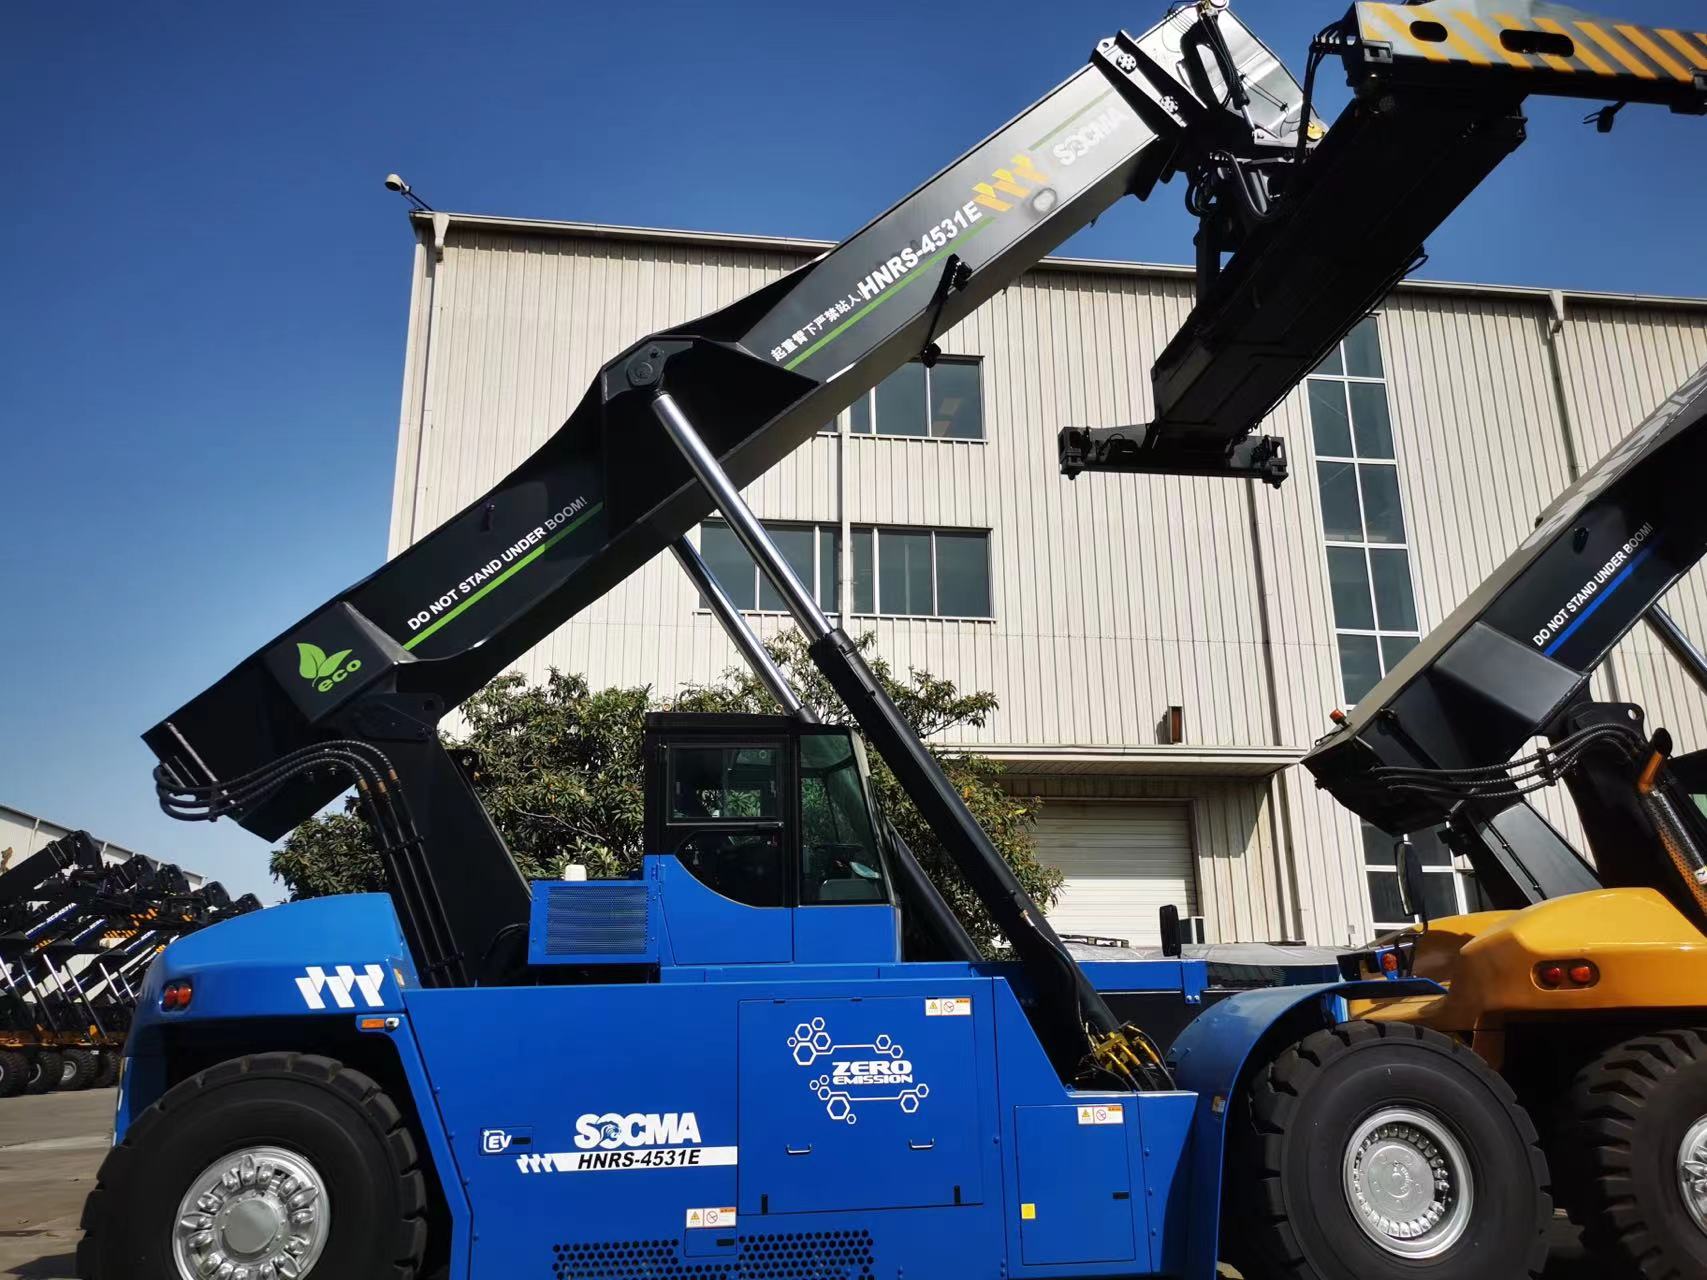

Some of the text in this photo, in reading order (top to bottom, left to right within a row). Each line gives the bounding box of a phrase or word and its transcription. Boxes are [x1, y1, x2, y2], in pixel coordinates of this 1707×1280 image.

[857, 201, 983, 300] HNRS-4531E
[408, 496, 588, 630] DO NOT STAND UNDER BOOM!
[1532, 521, 1653, 646] DO NOT STAND UNDER BOOM!
[318, 659, 361, 692] eco
[832, 1060, 912, 1076] ZERO
[832, 1074, 913, 1085] EMISSION
[488, 1135, 512, 1149] EV
[573, 1112, 701, 1149] SOCMA
[577, 1149, 701, 1170] HNRS-4531E
